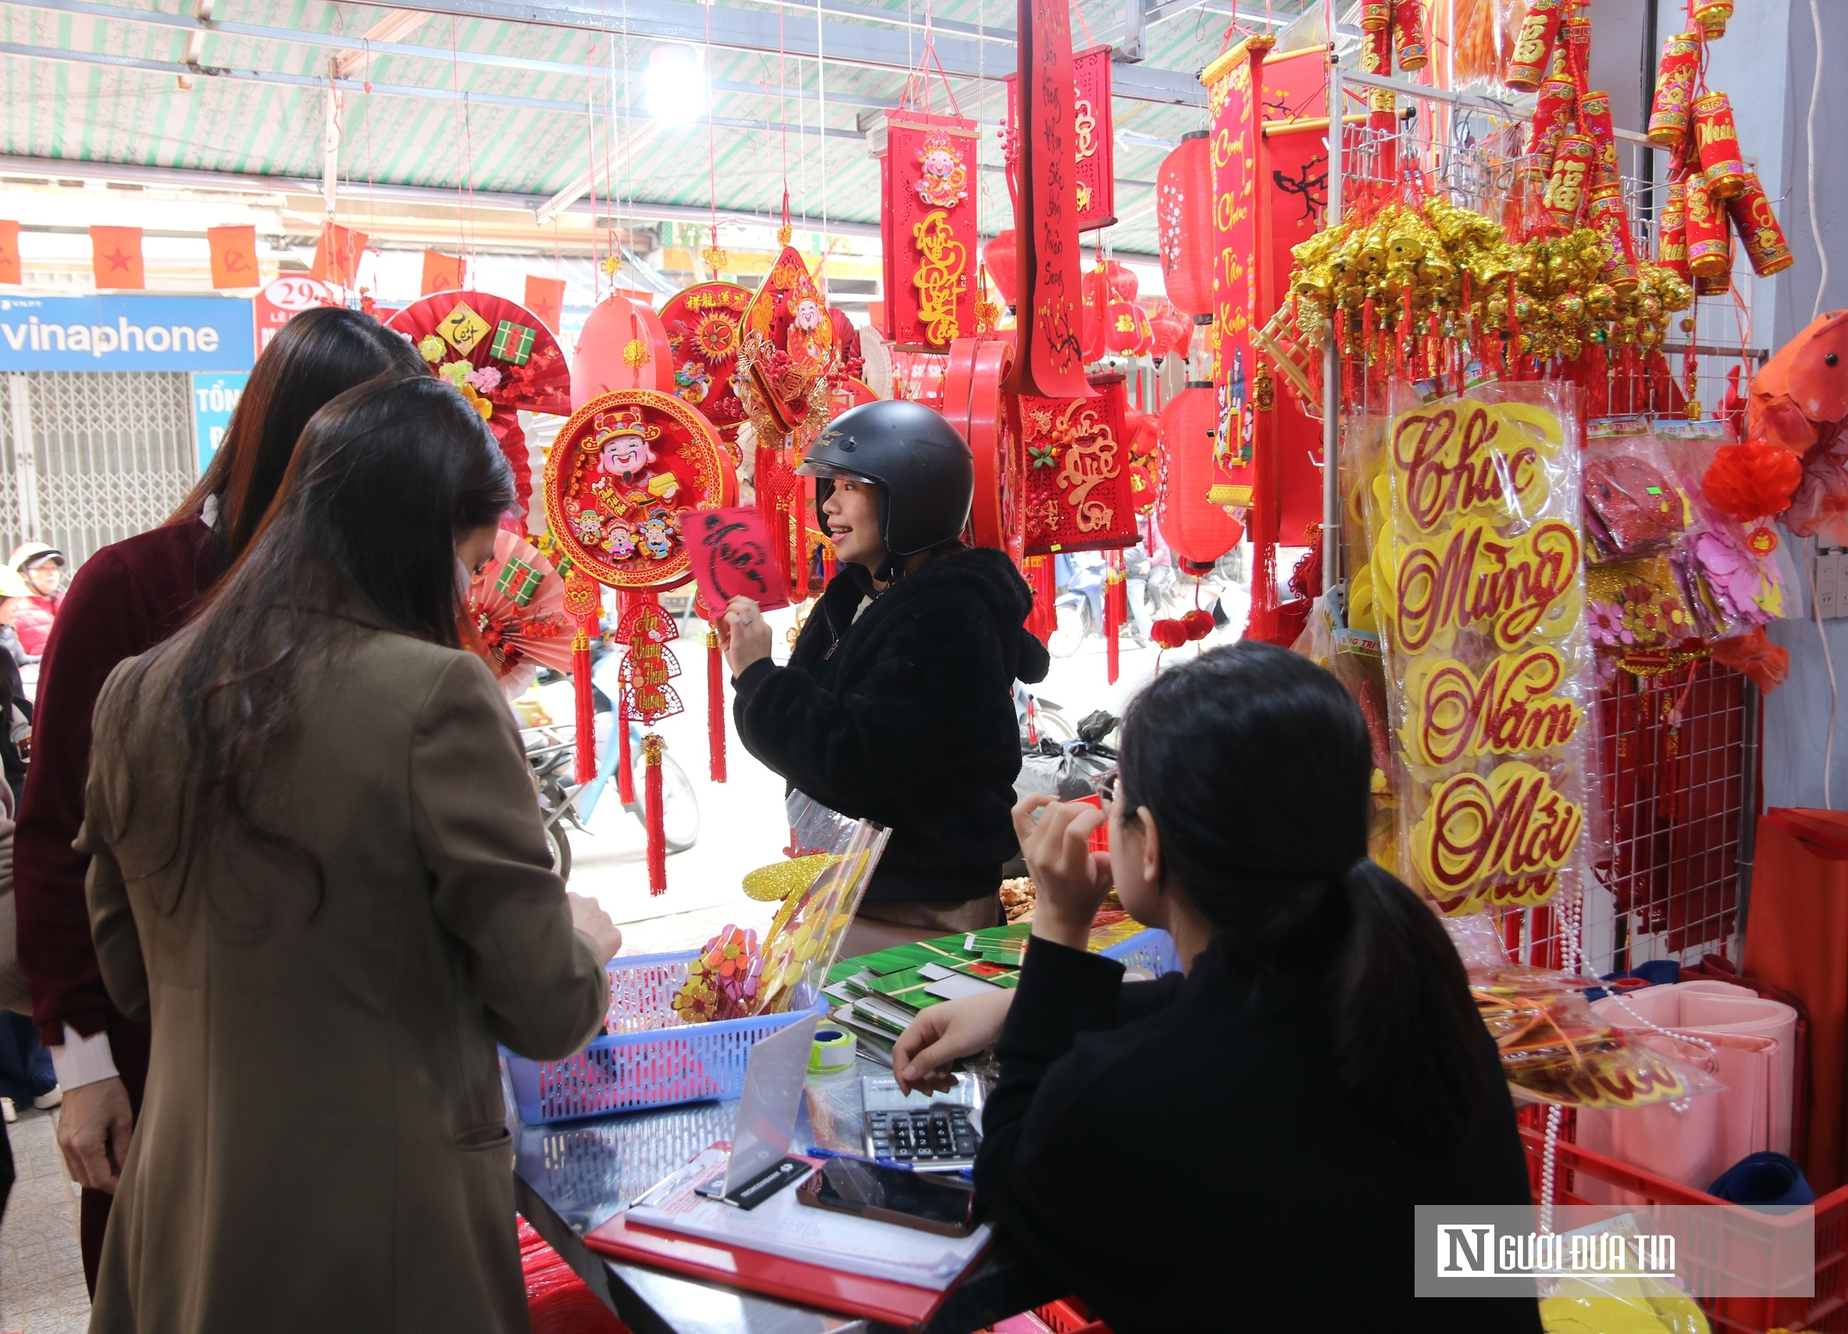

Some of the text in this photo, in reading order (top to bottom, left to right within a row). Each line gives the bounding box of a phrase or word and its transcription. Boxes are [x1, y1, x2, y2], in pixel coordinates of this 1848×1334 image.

[1543, 160, 1586, 211] 福
[1215, 128, 1247, 340] Cung Chúc Tân Xuân
[279, 282, 315, 304] 29
[0, 315, 220, 358] vinaphone
[451, 312, 479, 345] Tết
[1395, 407, 1538, 532] Chúc
[1398, 522, 1579, 652] Mừng
[635, 606, 658, 633] An
[631, 636, 662, 662] Khang
[1423, 649, 1579, 764] Năm
[1432, 774, 1581, 889] Mới
